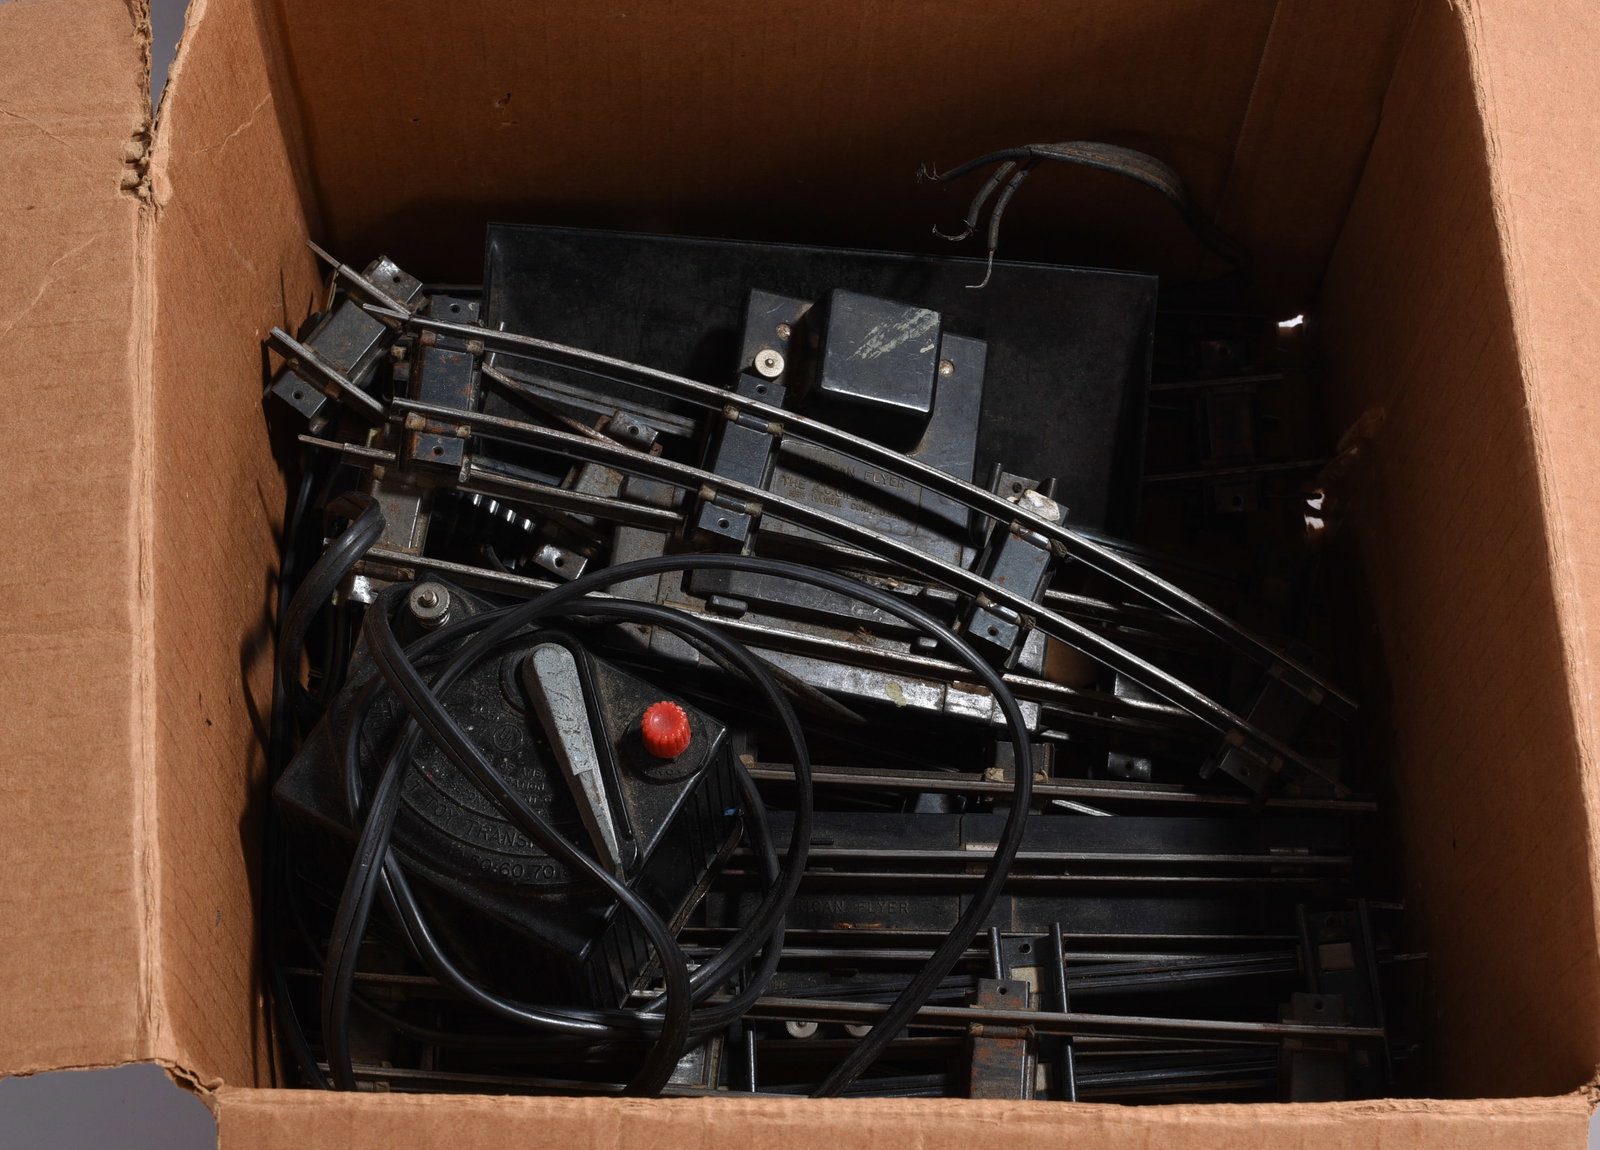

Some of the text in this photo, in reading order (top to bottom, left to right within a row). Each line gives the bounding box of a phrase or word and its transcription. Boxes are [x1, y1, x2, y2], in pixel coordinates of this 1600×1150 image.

[863, 470, 906, 489] FLYER
[424, 794, 460, 827] TOY
[499, 863, 524, 879] 60
[532, 865, 556, 880] 70
[786, 900, 910, 914] RICAN FLYER
